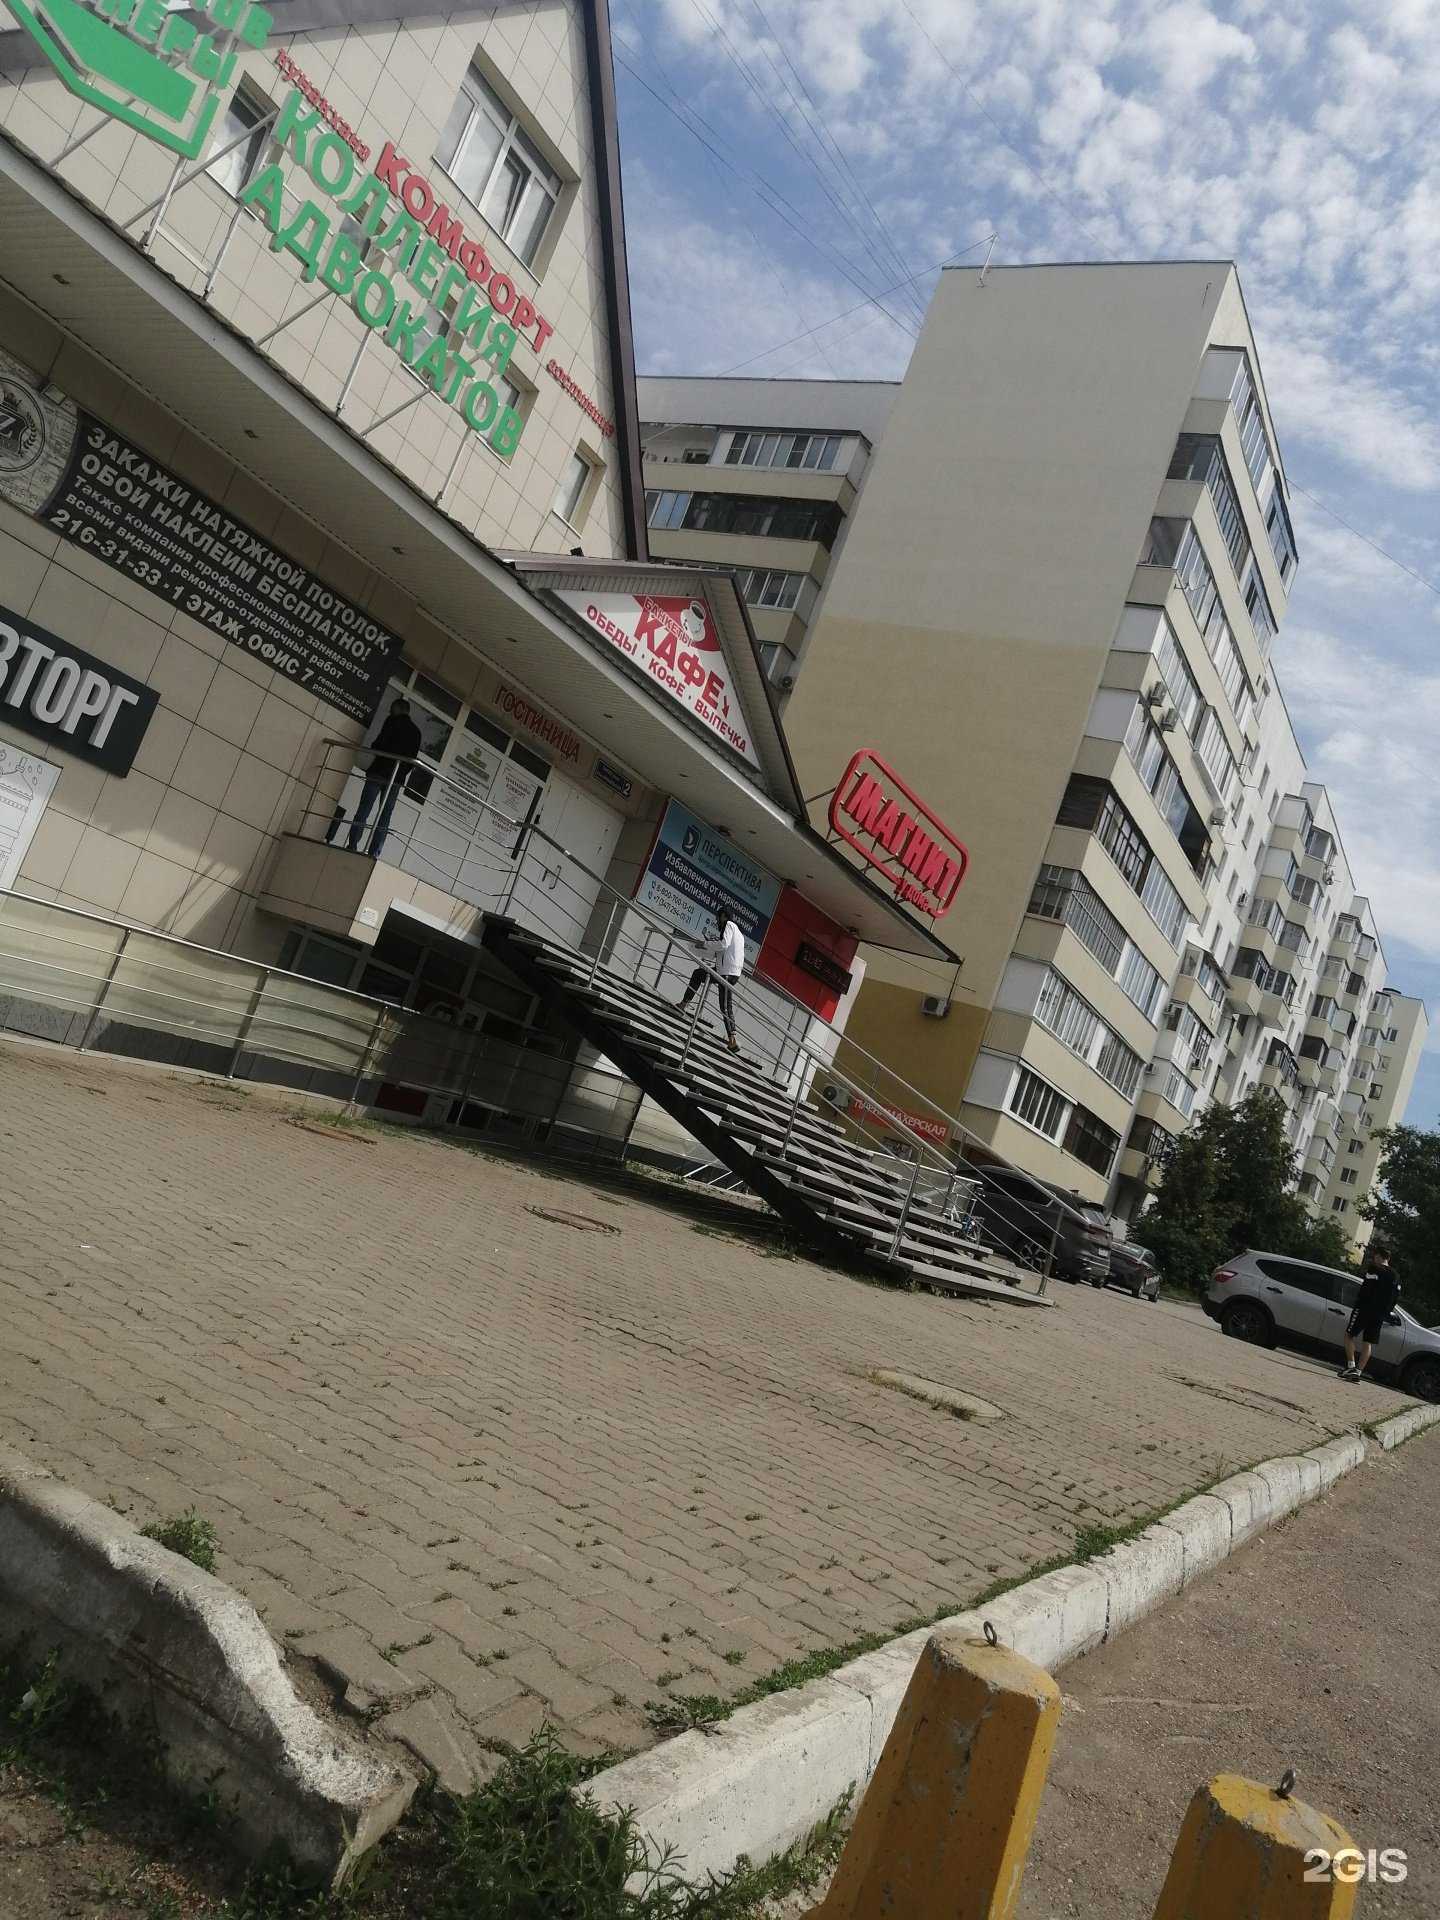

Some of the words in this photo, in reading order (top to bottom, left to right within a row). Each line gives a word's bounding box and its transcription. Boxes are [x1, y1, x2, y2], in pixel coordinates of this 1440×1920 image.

[239, 164, 525, 456] АДВОКАТОВ
[274, 89, 518, 376] КОЛЛЕГИЯ
[375, 141, 554, 354] КОМФОРТ
[50, 509, 161, 586] 216-31-33
[172, 584, 185, 601] 1
[186, 594, 246, 645] ЭТАЖ,
[247, 633, 300, 675] ОФИС
[300, 667, 315, 683] 7
[66, 493, 115, 529] всеми
[116, 526, 171, 566] видами
[170, 562, 308, 658] ремонтно-отделочных
[309, 653, 344, 680] работ
[74, 475, 122, 515] Также
[125, 512, 193, 563] компания
[195, 559, 305, 638] профессионально
[306, 634, 370, 682] занимается
[81, 454, 151, 509] ОБОИ
[151, 502, 257, 583] НАКЛЕИМ
[256, 575, 372, 662] БЕСПЛАТНО!
[88, 428, 191, 508] ЗАКАЖИ
[190, 502, 306, 590] НАТЯЖНОЙ
[305, 583, 391, 655] ПОТОЛОК,
[586, 604, 637, 656] ОБЕДЫ
[648, 658, 686, 698] КОФЕ
[694, 699, 747, 752] ВЫПЕЧКА
[634, 606, 725, 711] КАФЕ
[644, 597, 697, 648] БАНКЕТЫ
[494, 684, 581, 763] ГОСТИНИЦА
[664, 850, 709, 889] Избавление
[709, 882, 719, 895] от
[664, 867, 711, 905] алкоголизма
[702, 840, 762, 893] ПЕРСПЕКТИВА
[844, 772, 959, 902] МАГНИТ
